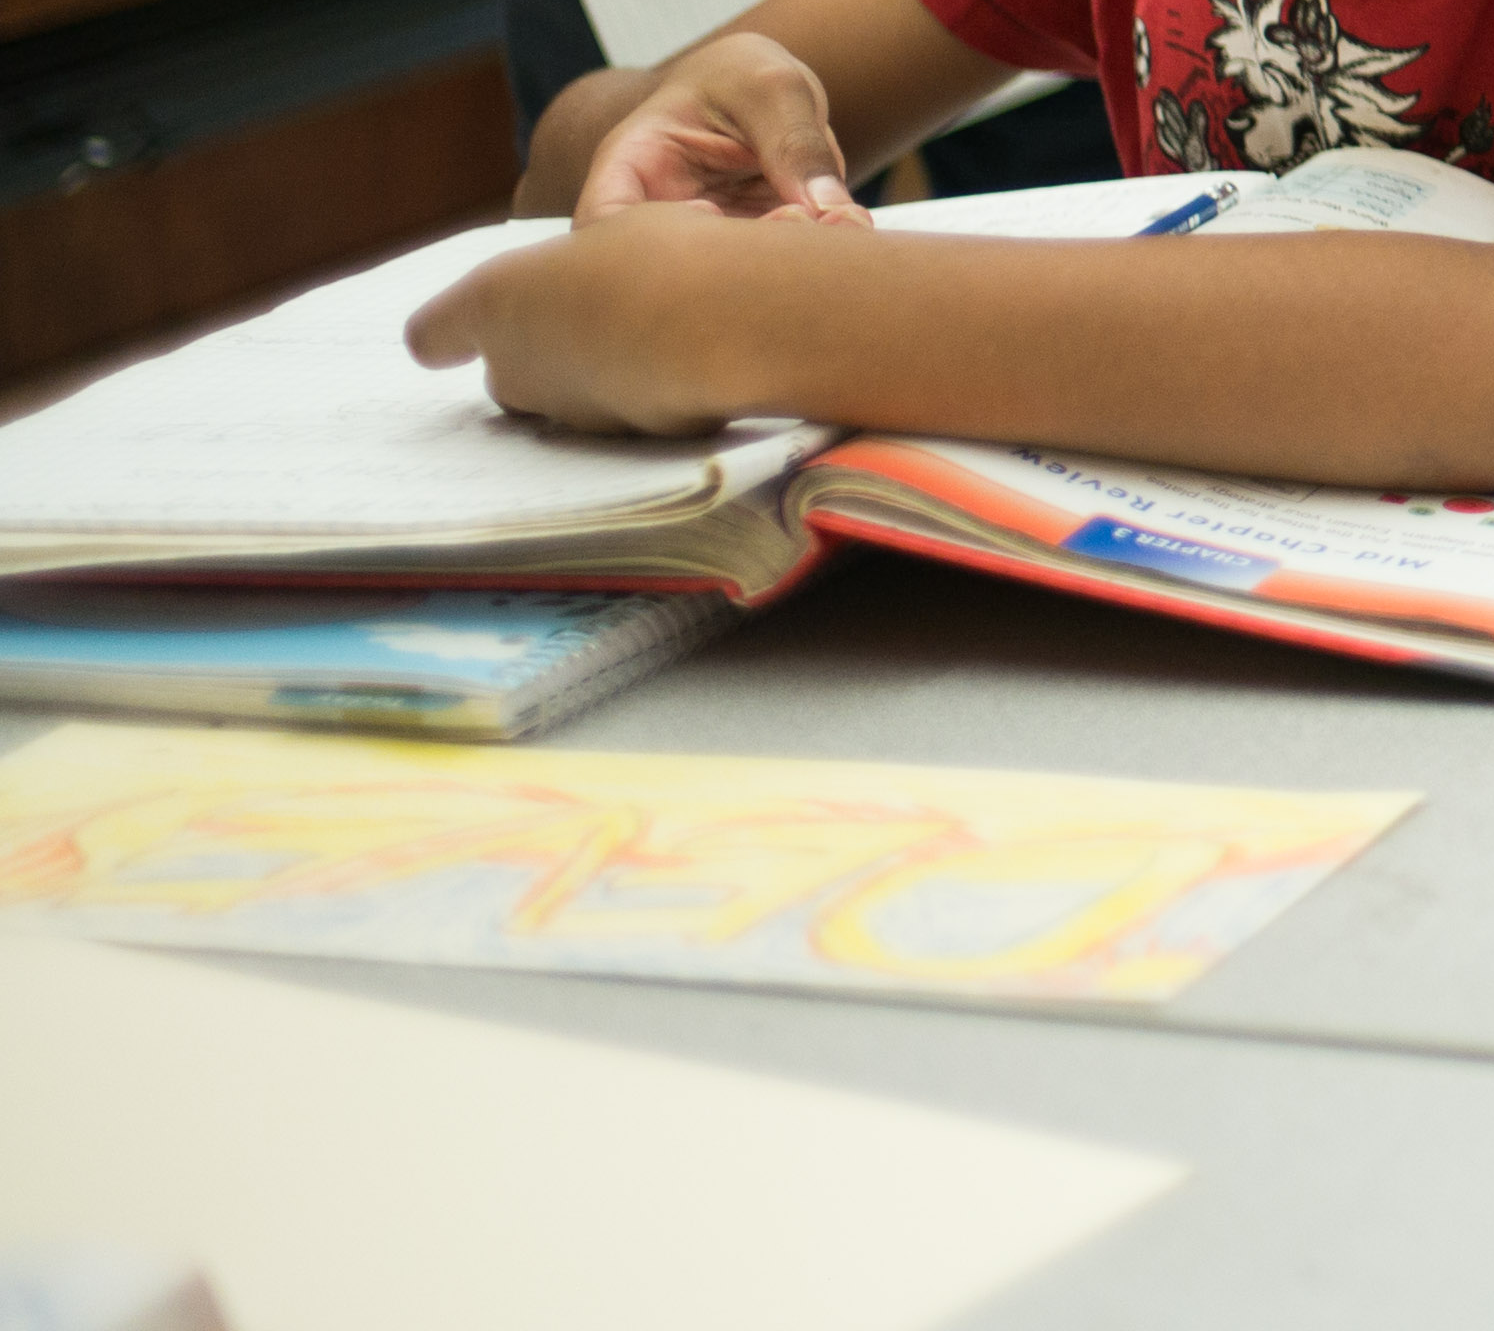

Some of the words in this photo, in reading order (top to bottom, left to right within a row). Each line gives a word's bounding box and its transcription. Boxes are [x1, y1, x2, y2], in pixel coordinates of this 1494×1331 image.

[1011, 447, 1156, 511] Review
[1112, 527, 1133, 539] 3
[1135, 533, 1251, 566] CHAPTER
[1166, 510, 1432, 569] Mid-Chapter
